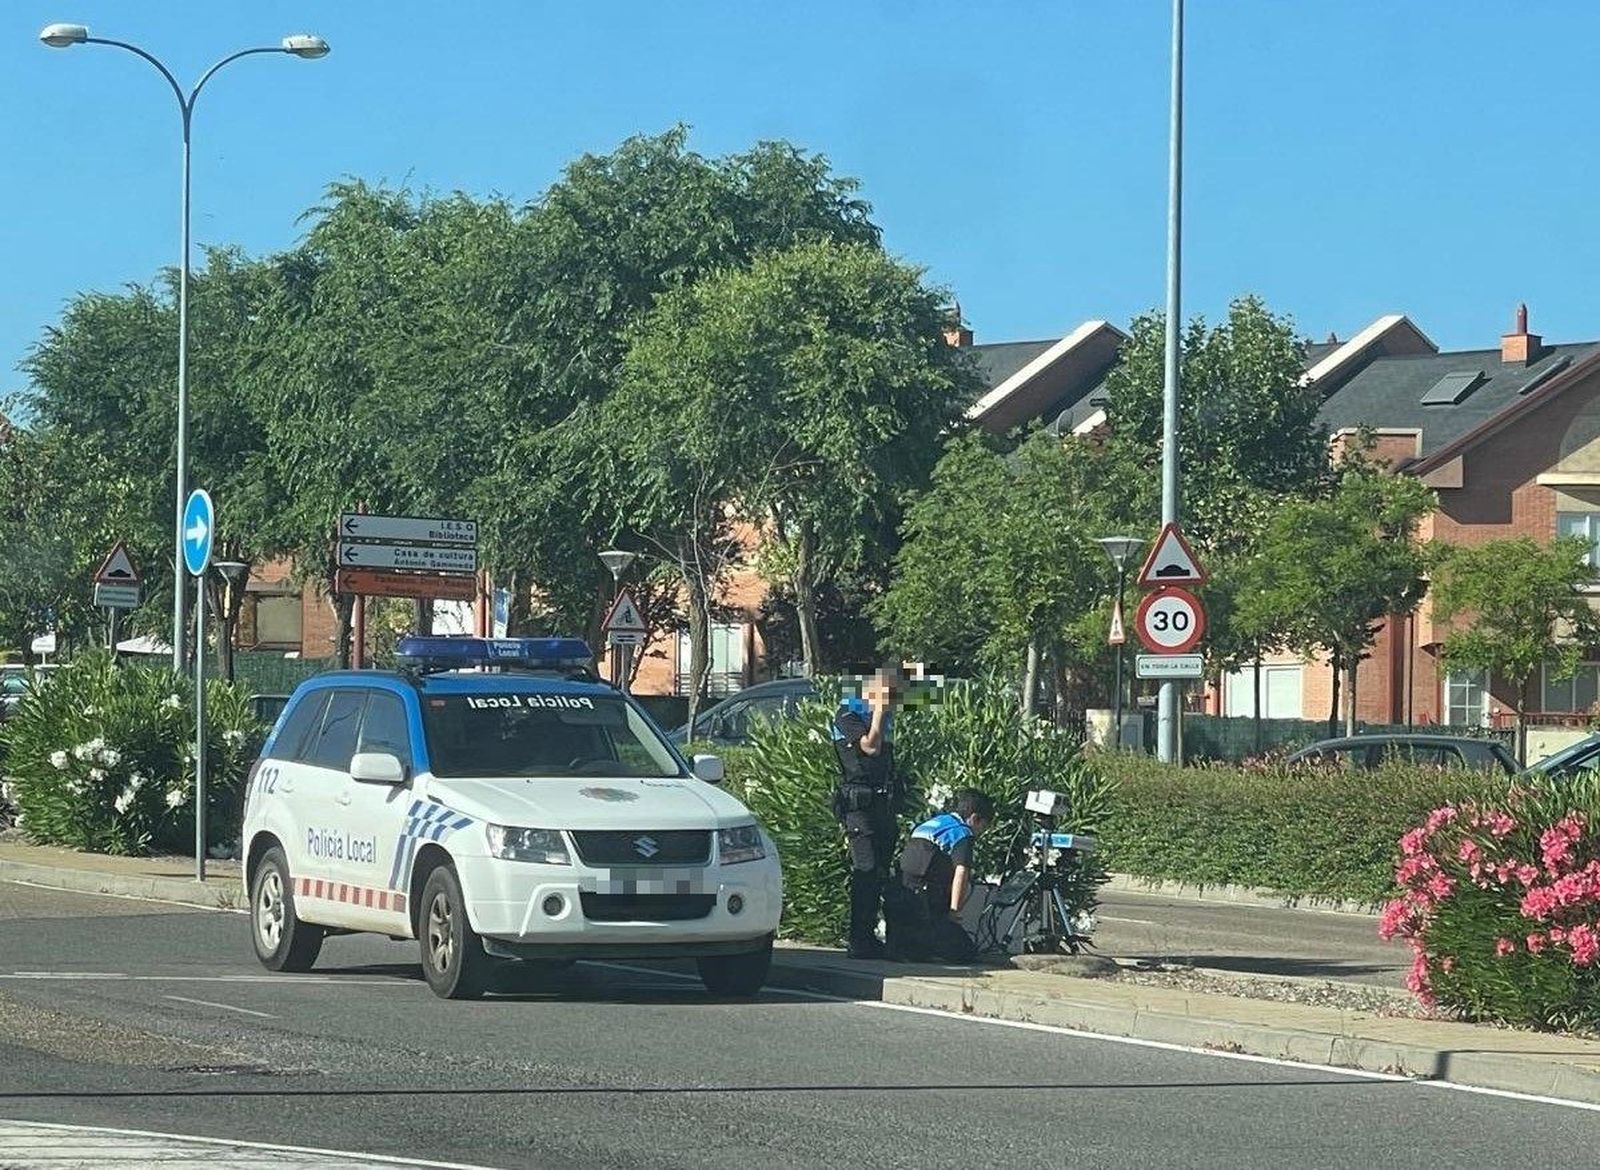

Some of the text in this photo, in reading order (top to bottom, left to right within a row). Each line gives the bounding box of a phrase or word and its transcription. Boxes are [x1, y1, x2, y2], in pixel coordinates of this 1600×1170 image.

[429, 530, 474, 541] Biblioteca
[394, 548, 473, 561] Casa de cultura
[1153, 611, 1189, 631] 30
[258, 767, 280, 794] 112
[347, 834, 376, 863] Local
